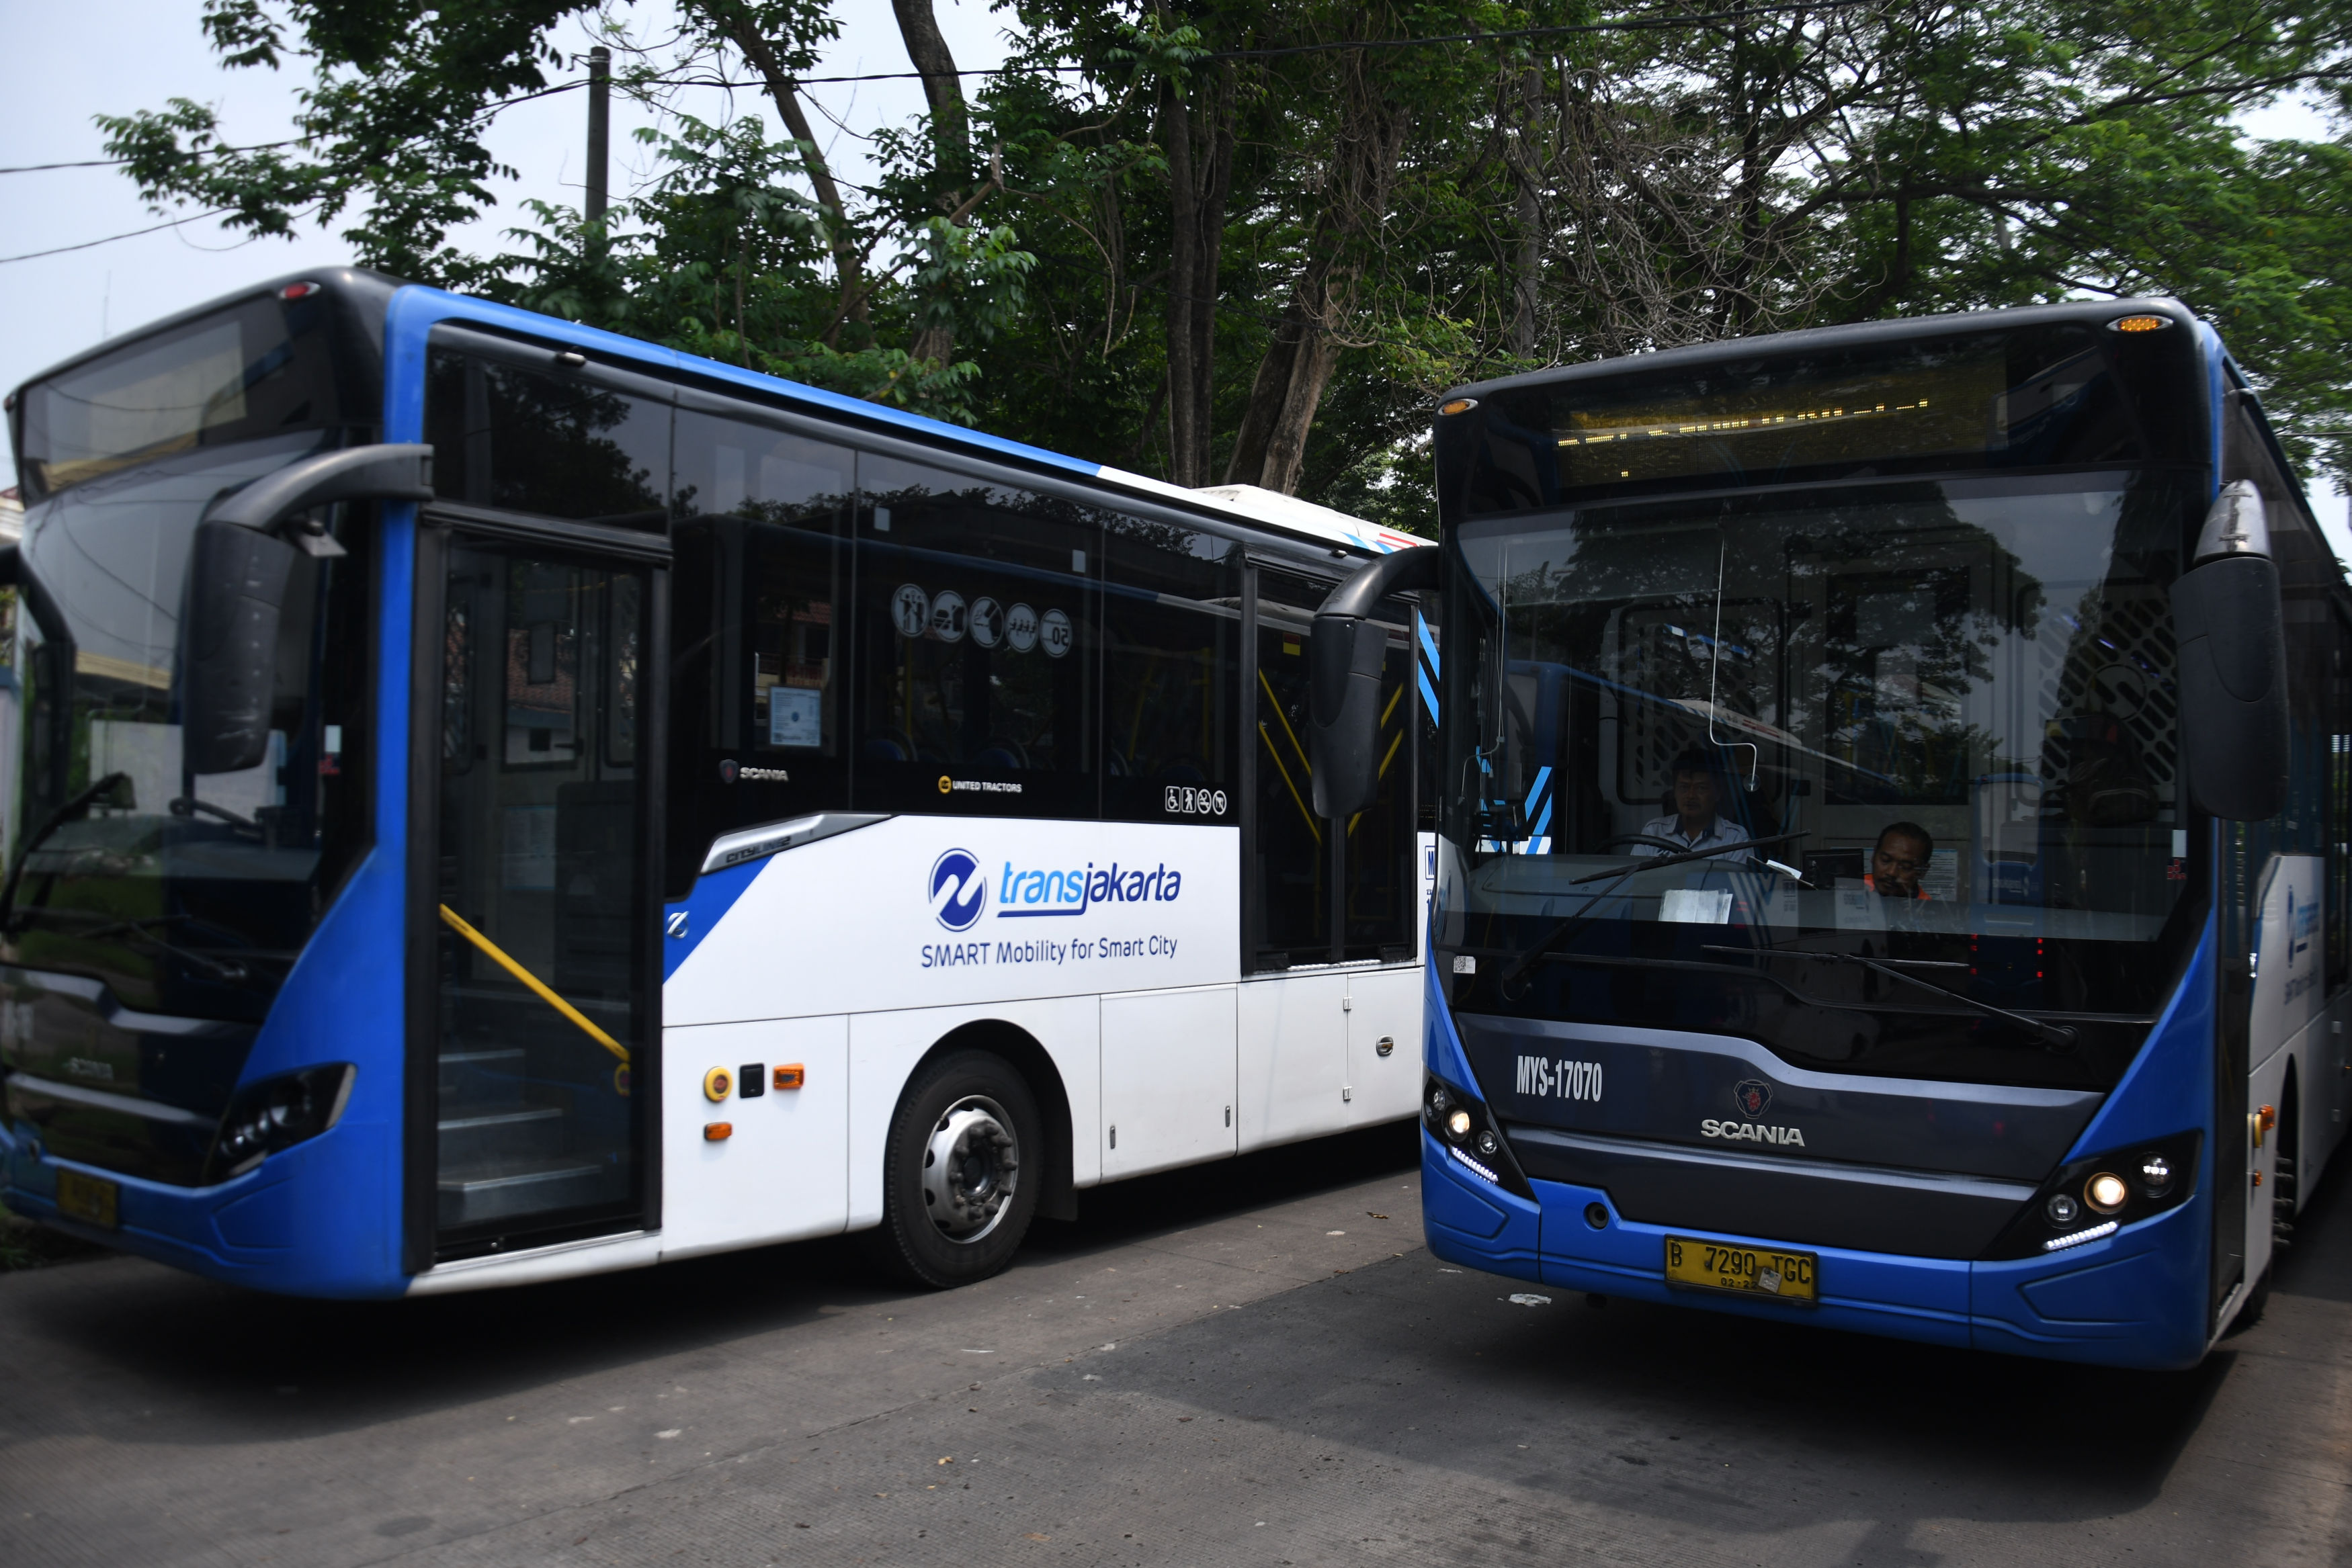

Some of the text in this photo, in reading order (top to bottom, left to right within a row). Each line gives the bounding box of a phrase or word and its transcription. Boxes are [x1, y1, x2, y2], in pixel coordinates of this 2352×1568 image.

[740, 767, 789, 782] SCANIA
[952, 781, 981, 791] UNITED
[982, 782, 1022, 793] TRACTORS
[997, 861, 1182, 918] transjakarta
[921, 934, 1178, 968] SMART Mobility for Smart City
[1516, 1055, 1603, 1102] MYS-17070
[1700, 1119, 1806, 1147] SCANIA
[1671, 1242, 1682, 1267] B
[1704, 1246, 1756, 1276] 7290
[1771, 1255, 1810, 1284] TGC
